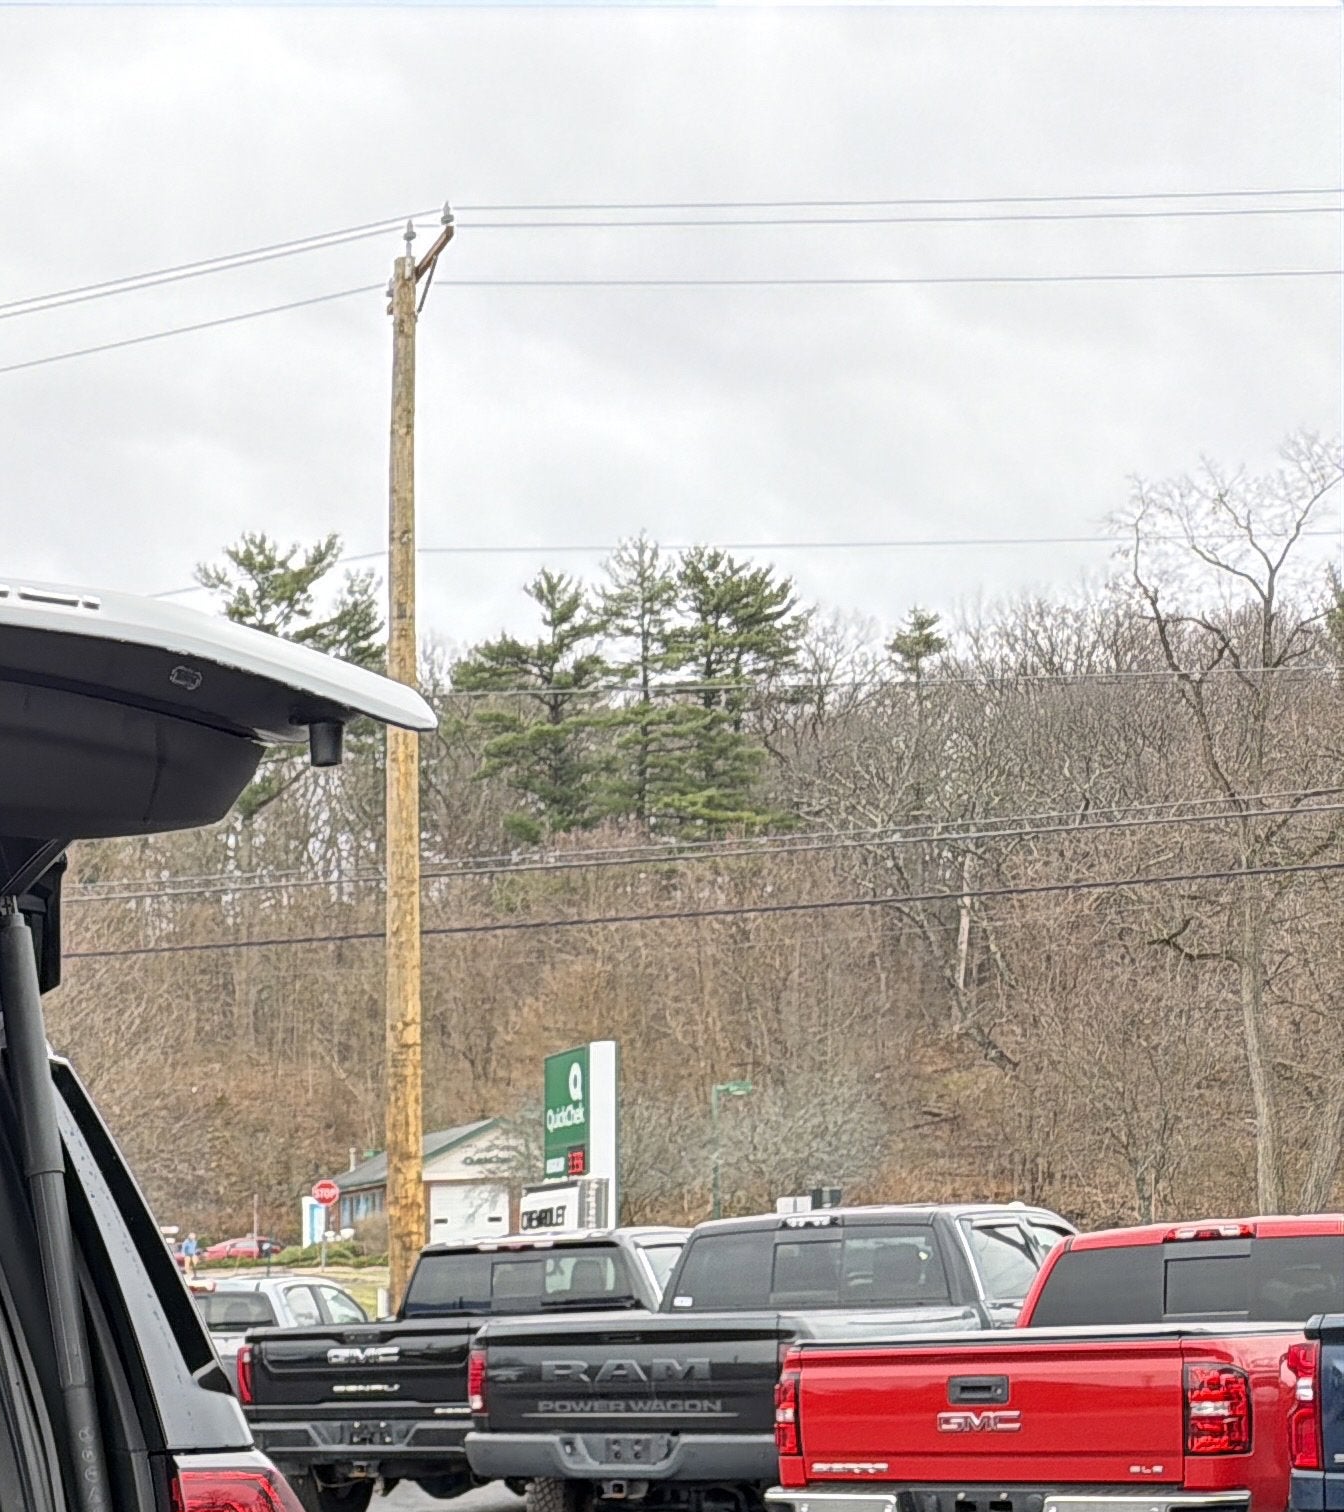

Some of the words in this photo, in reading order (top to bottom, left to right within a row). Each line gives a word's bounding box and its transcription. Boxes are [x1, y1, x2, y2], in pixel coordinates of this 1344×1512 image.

[546, 1103, 586, 1133] QuickChek
[314, 1187, 339, 1200] STOP
[541, 1357, 711, 1383] RAM
[537, 1400, 626, 1412] POWER
[628, 1400, 723, 1412] WAGON
[936, 1410, 1022, 1432] GMC
